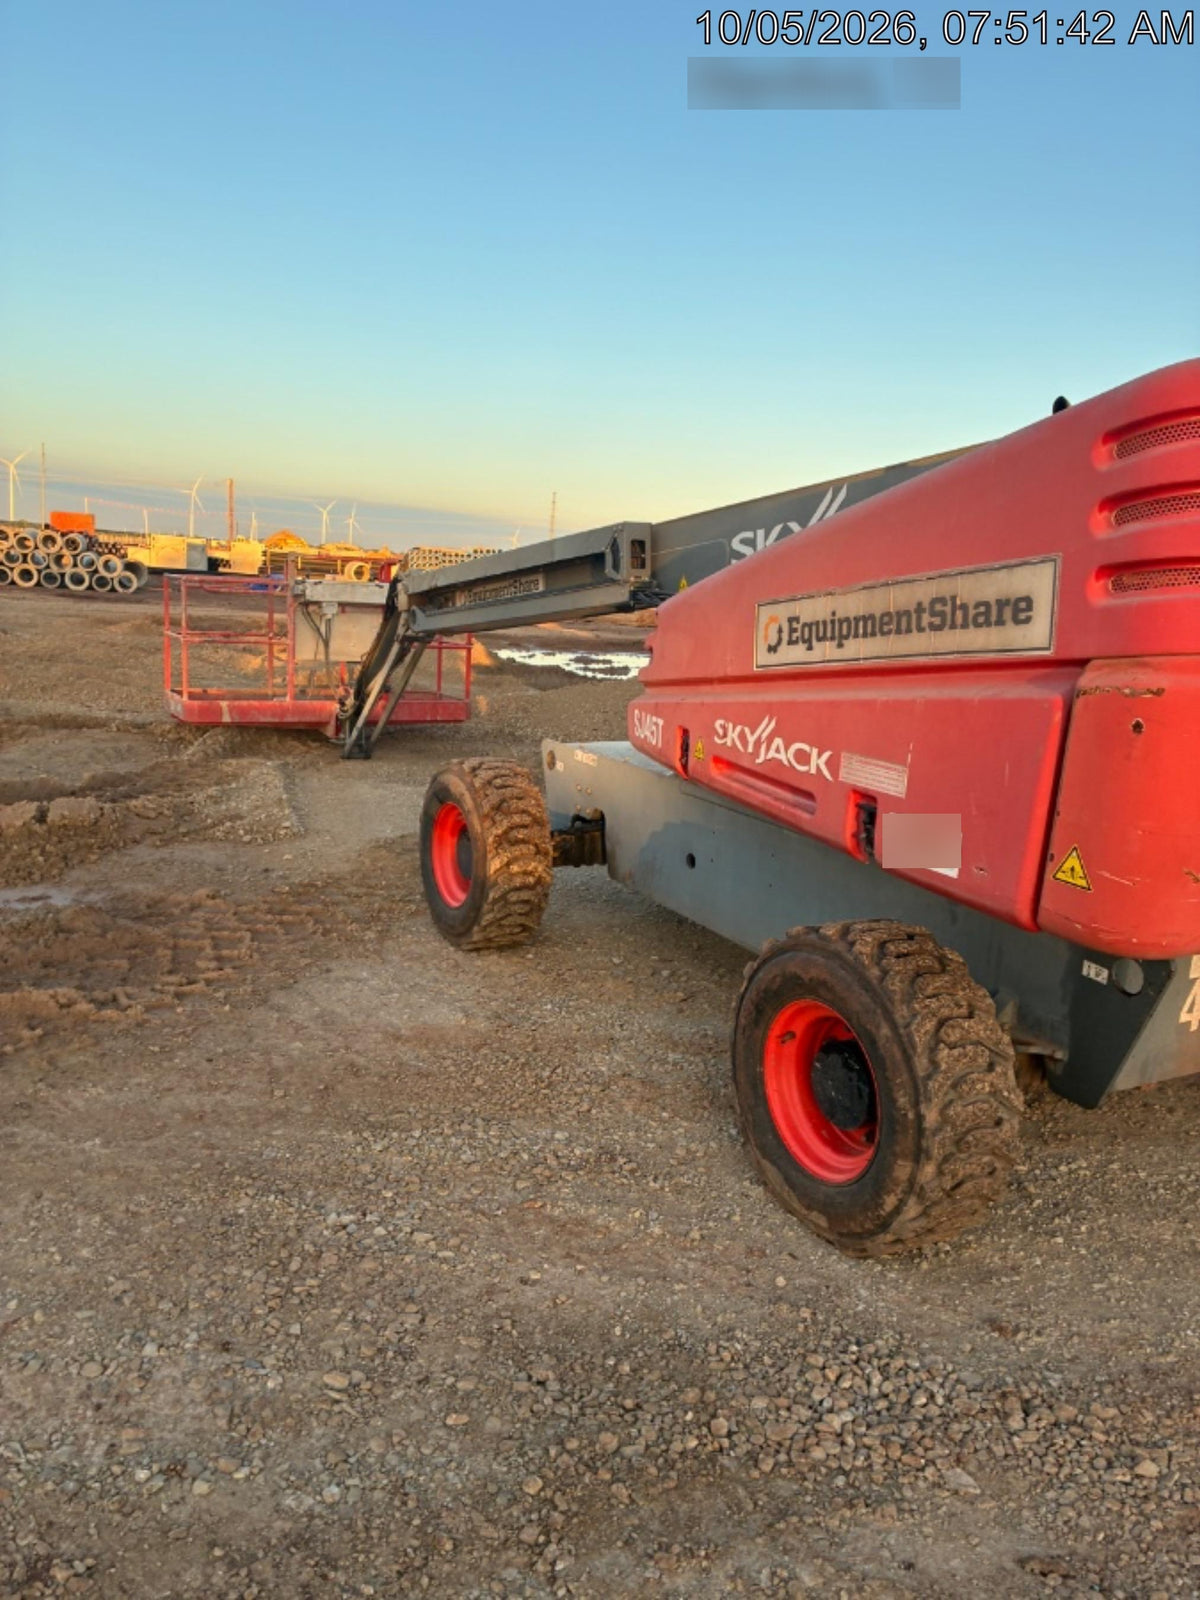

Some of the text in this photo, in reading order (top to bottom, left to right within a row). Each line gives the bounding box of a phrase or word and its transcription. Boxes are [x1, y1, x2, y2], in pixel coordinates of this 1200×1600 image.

[730, 483, 847, 565] SKY
[786, 594, 1034, 651] EquipmentShare
[634, 709, 664, 748] SJ45T
[713, 715, 834, 782] SKYJACK
